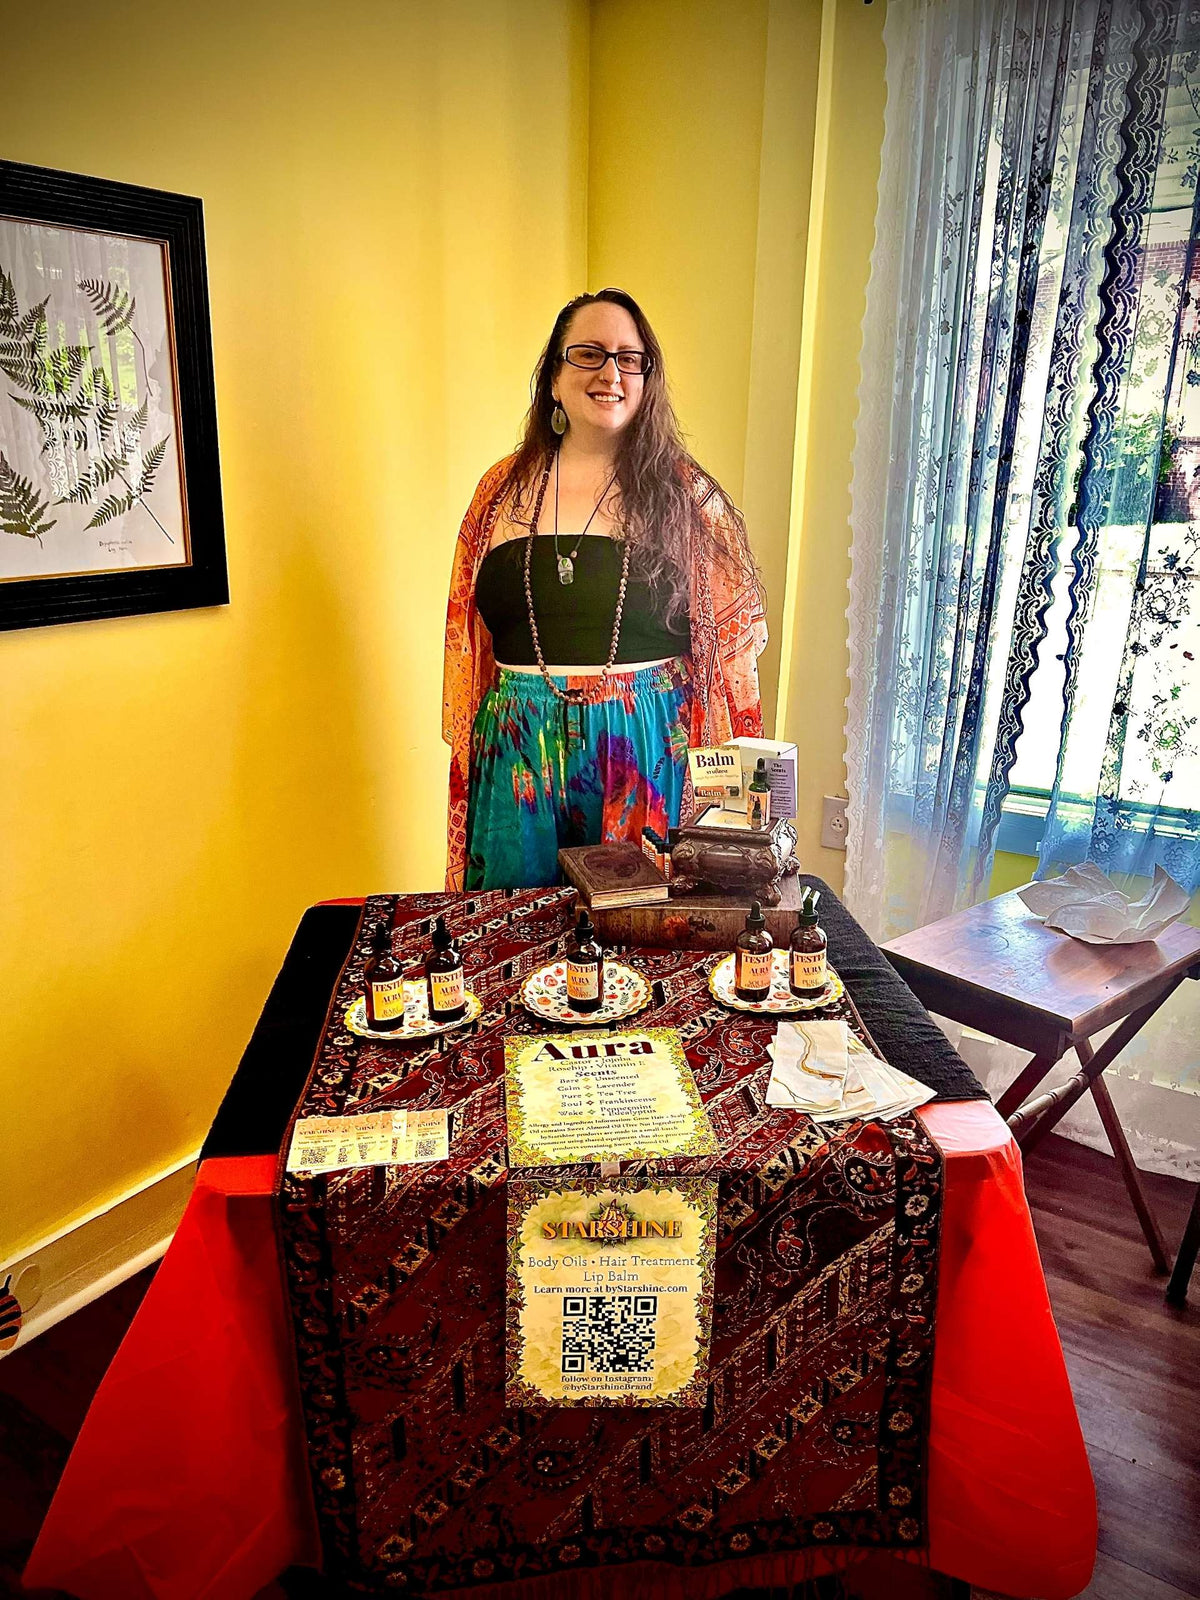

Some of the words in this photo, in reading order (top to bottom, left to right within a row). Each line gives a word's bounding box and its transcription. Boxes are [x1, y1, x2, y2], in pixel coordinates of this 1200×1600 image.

[695, 752, 735, 768] Balm
[700, 789, 721, 797] Balm
[531, 1041, 656, 1062] Aura
[599, 1097, 657, 1105] Frankincense
[600, 1104, 652, 1113] Peppermint
[608, 1108, 657, 1116] Eucalyptus
[542, 1220, 682, 1240] STARSHINE
[528, 1256, 559, 1270] Body
[562, 1256, 587, 1267] Oils
[600, 1256, 627, 1267] Hair
[631, 1255, 695, 1266] Treatment
[583, 1271, 604, 1285] Lip
[607, 1270, 639, 1282] Balm
[534, 1285, 563, 1294] Learn
[594, 1285, 603, 1293] at
[606, 1284, 688, 1295] byStarshine.com
[562, 1383, 652, 1392] @byStarshineBrand
